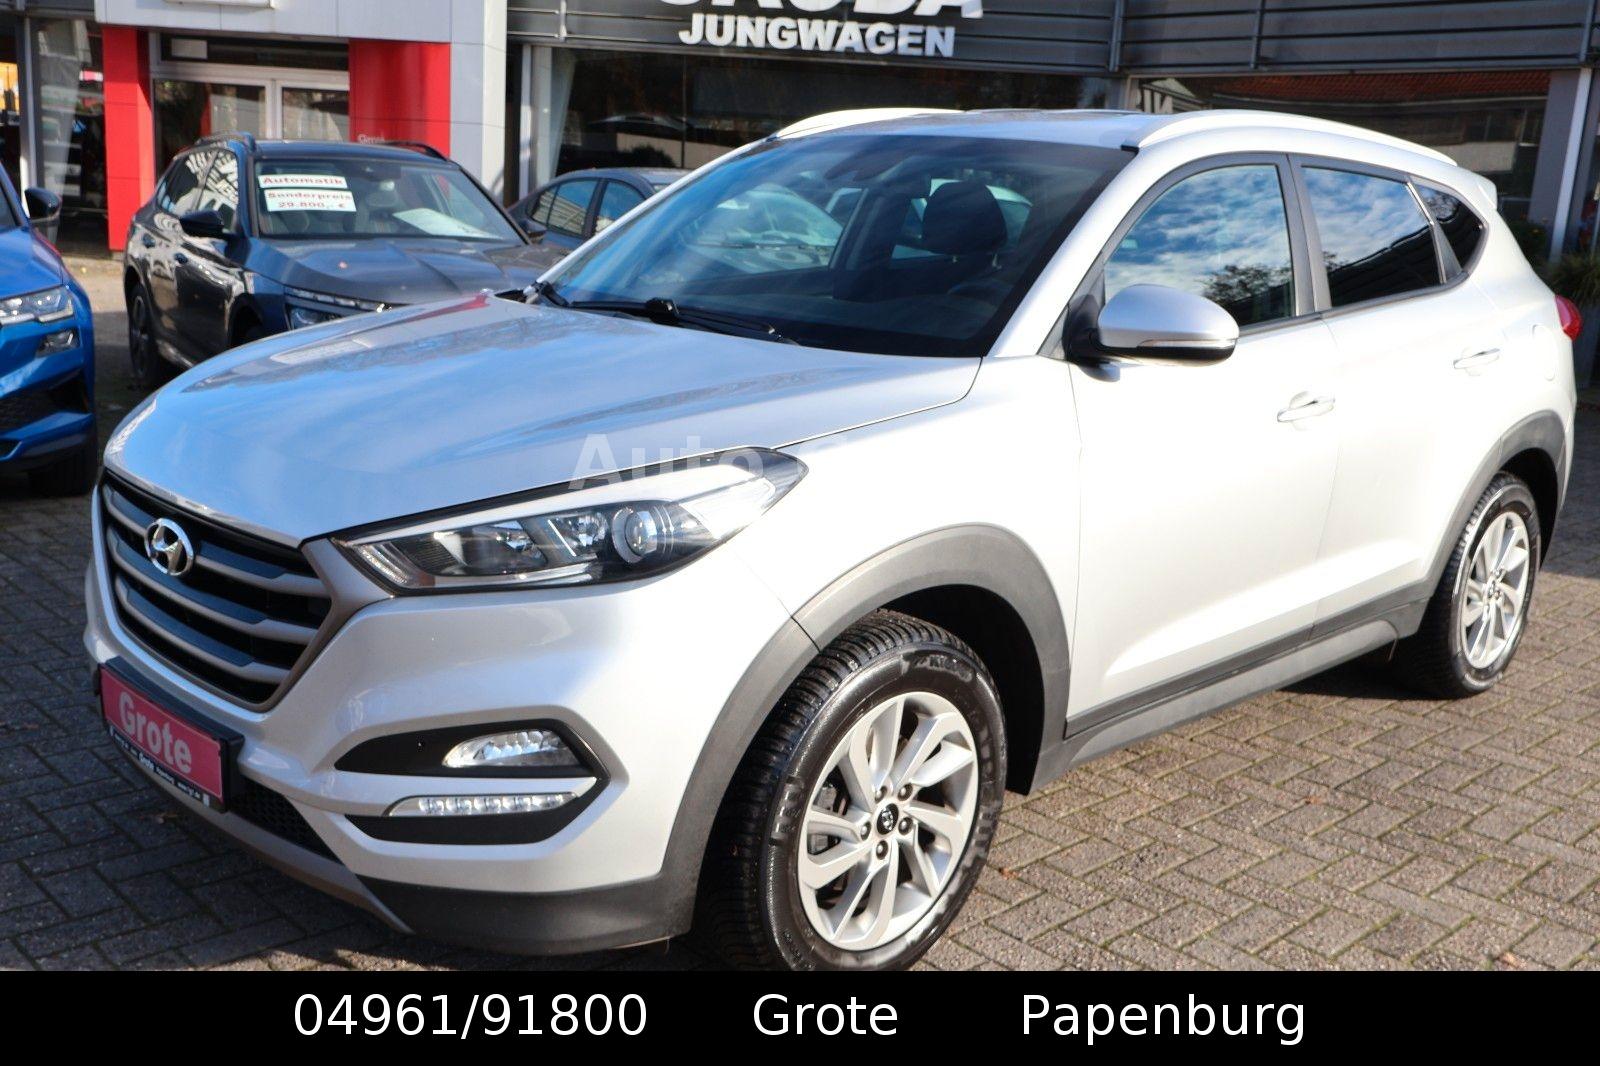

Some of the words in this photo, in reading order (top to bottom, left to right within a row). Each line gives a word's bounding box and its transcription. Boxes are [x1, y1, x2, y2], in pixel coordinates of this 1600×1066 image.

[678, 13, 955, 57] JUNGWAGEN
[264, 176, 343, 185] Automatik
[268, 191, 353, 201] Sonderpreis
[119, 691, 192, 774] Grote
